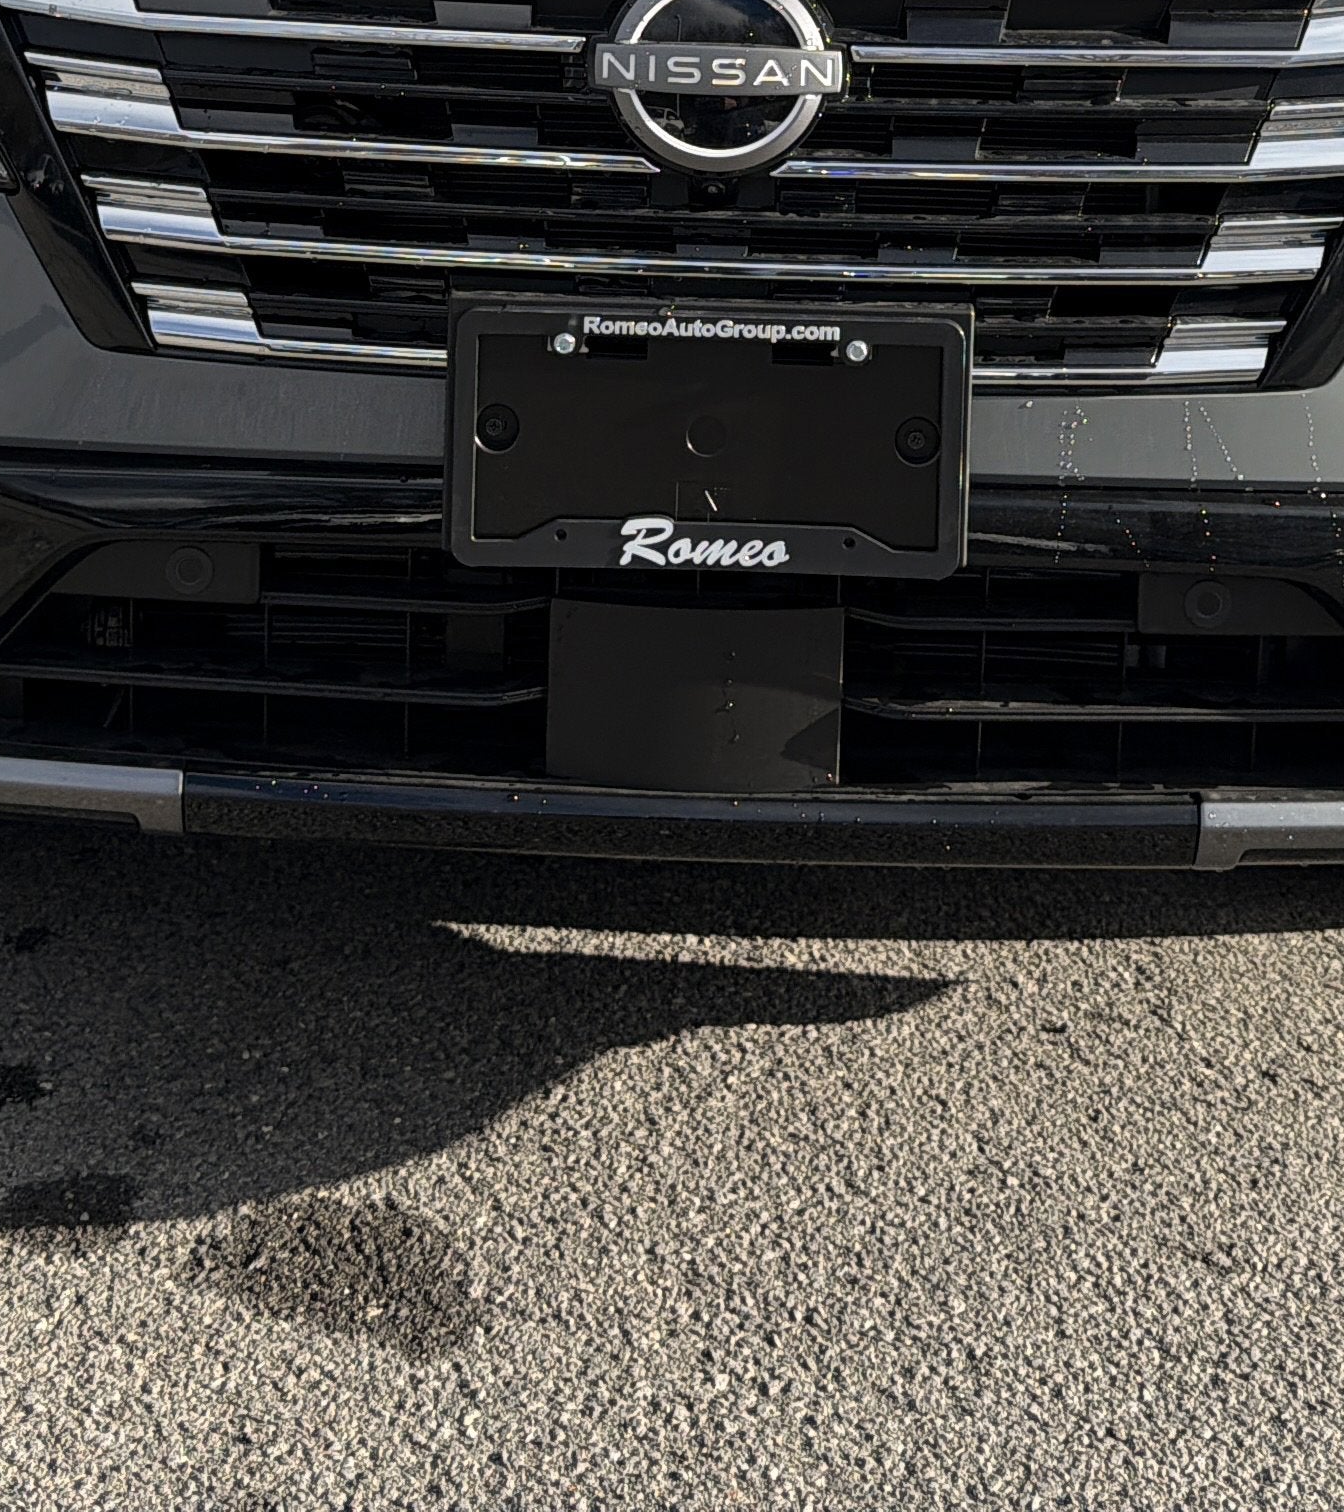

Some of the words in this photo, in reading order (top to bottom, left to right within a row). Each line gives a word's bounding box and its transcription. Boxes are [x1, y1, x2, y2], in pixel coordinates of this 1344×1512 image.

[602, 52, 833, 87] NISSAN
[583, 316, 841, 343] RomeoAutoGroup.com
[619, 517, 790, 567] Romeo
